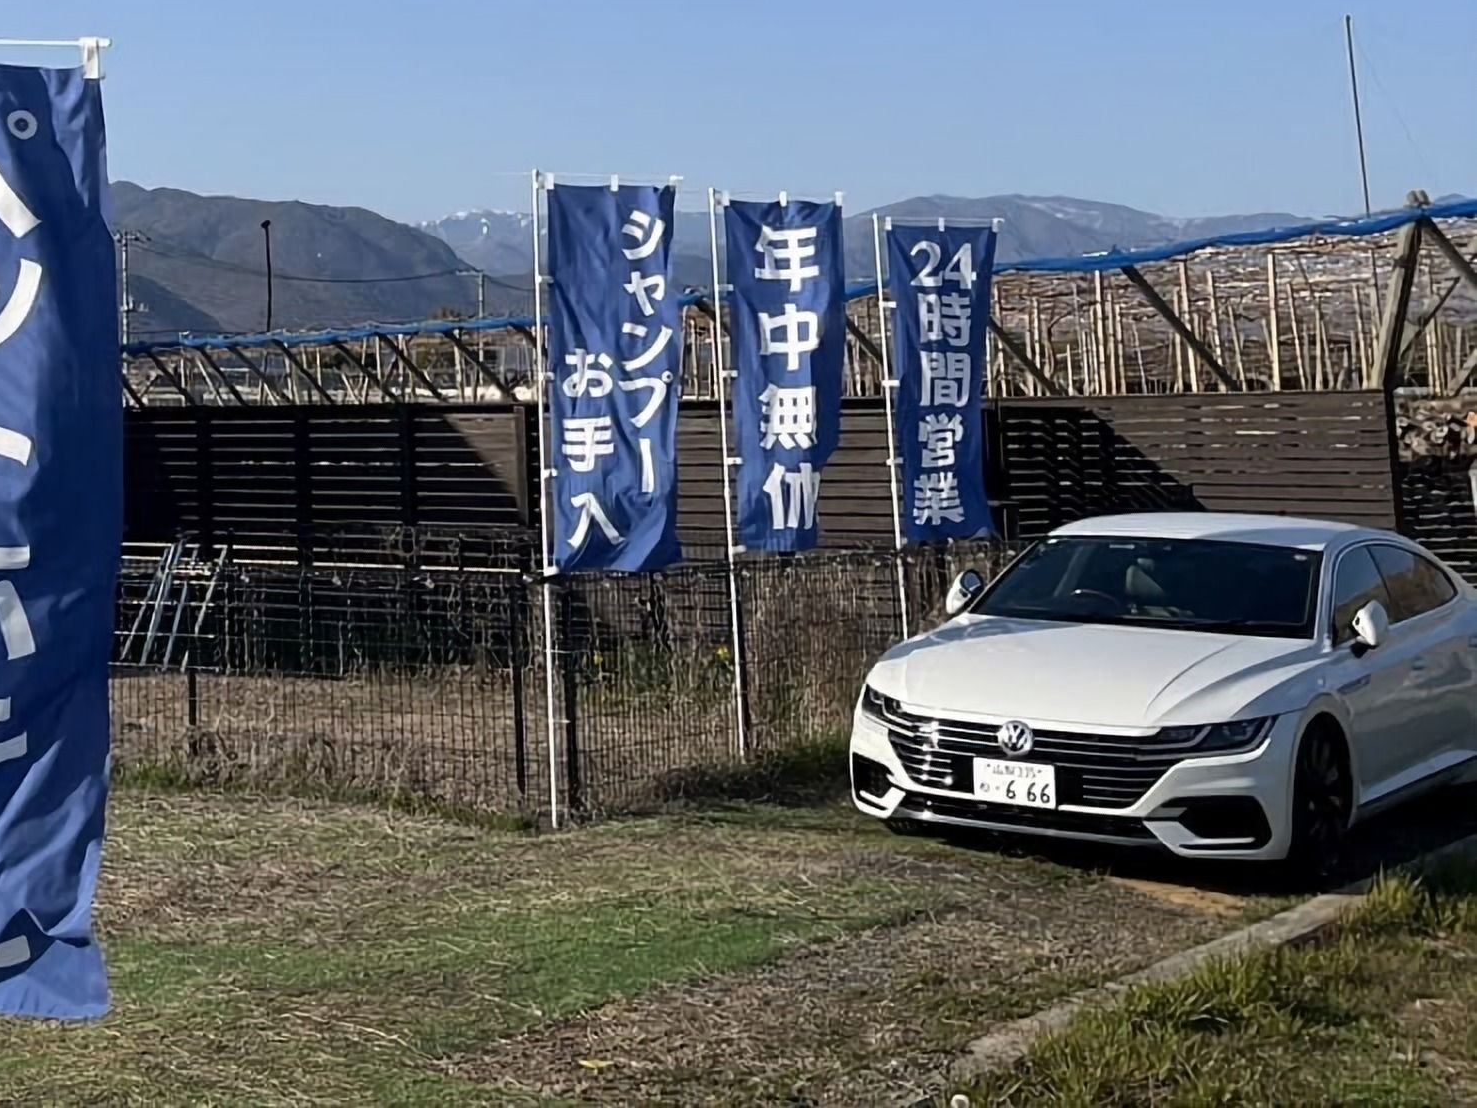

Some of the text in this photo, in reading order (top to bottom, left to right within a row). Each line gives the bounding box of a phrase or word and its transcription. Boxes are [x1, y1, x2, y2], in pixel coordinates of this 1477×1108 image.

[618, 209, 673, 493] シャンプー
[909, 240, 978, 526] 24時間営業
